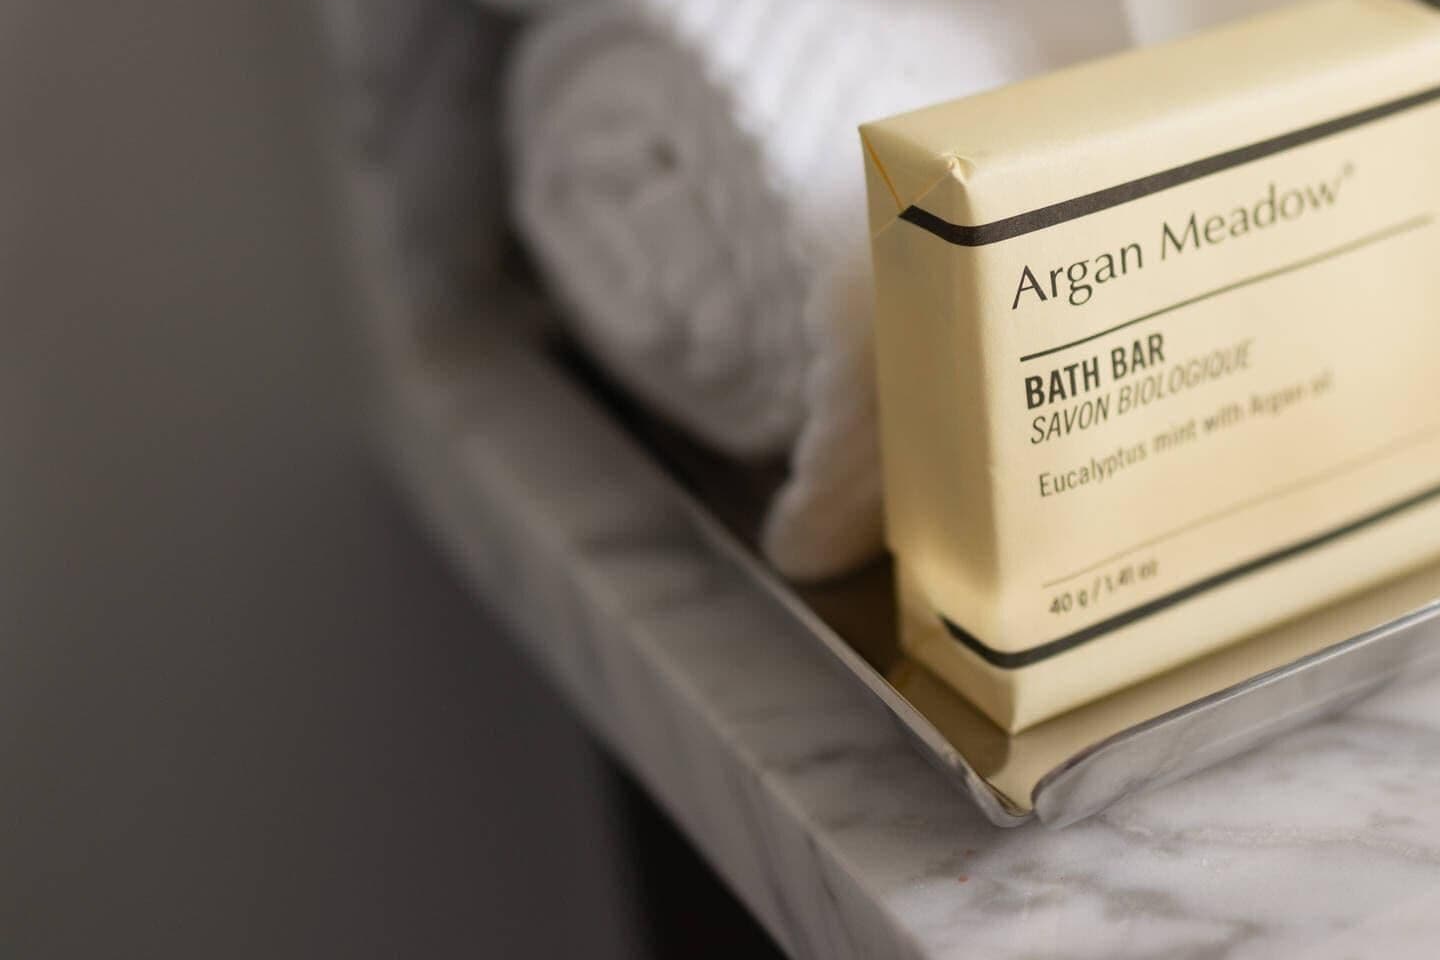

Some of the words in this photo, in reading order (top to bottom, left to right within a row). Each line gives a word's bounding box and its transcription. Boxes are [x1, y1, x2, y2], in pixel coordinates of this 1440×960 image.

[1011, 241, 1143, 310] Argan
[1024, 355, 1101, 411] BATH
[1110, 332, 1166, 382] BAR
[1029, 392, 1111, 445] SAVON
[1116, 337, 1255, 415] BIOLOGIQUE
[1038, 439, 1148, 498] Eucalyptus
[1152, 419, 1199, 454] mint
[1202, 402, 1246, 436] with
[1249, 383, 1305, 418] Argan
[1048, 591, 1073, 616] 40
